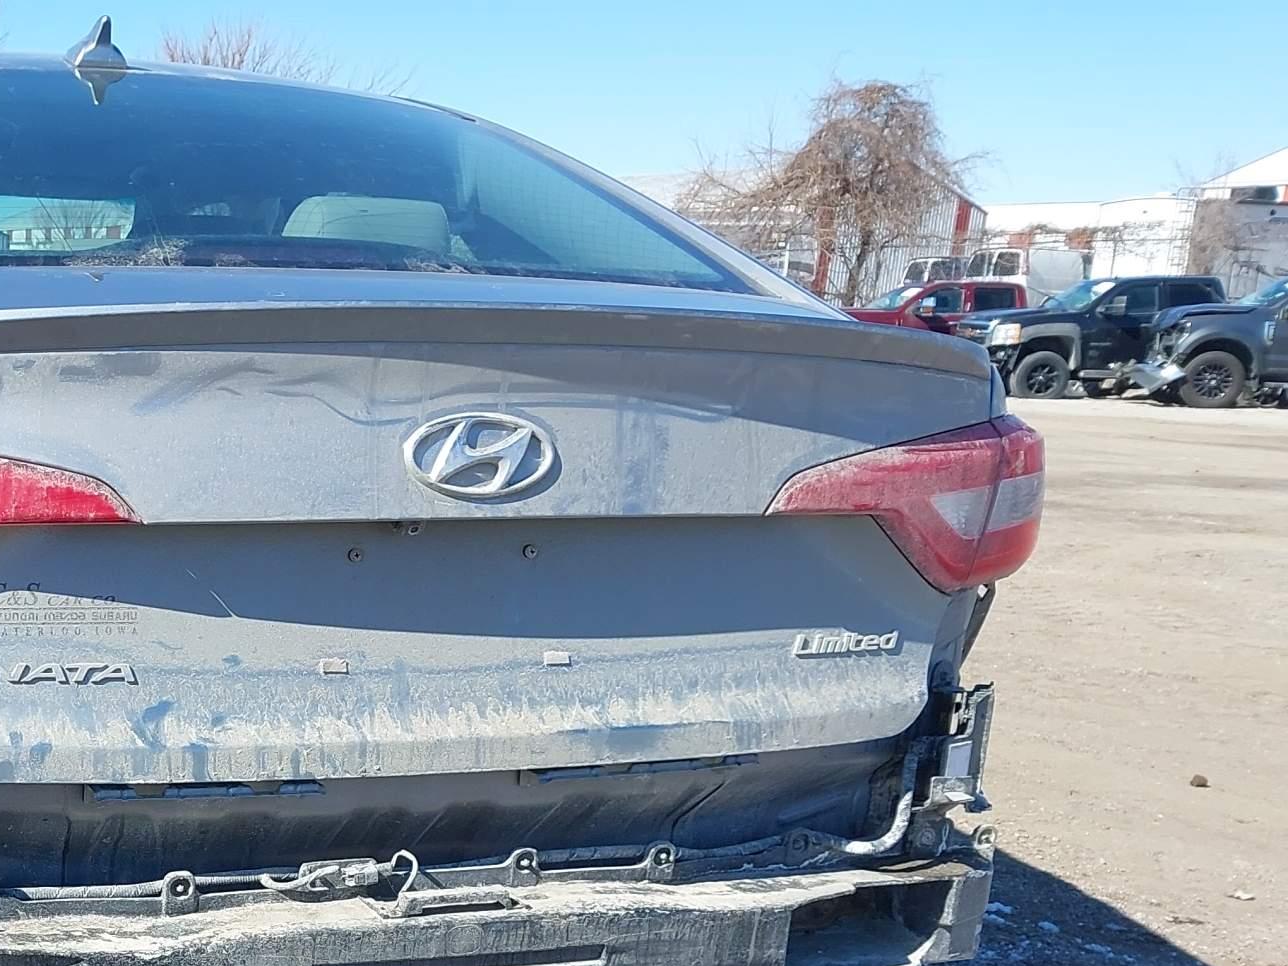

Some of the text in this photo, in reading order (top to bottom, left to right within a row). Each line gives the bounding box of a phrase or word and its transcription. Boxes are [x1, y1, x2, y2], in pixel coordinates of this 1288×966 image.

[91, 611, 138, 621] SUBARU
[95, 626, 139, 636] IOWA
[792, 629, 901, 657] Limited
